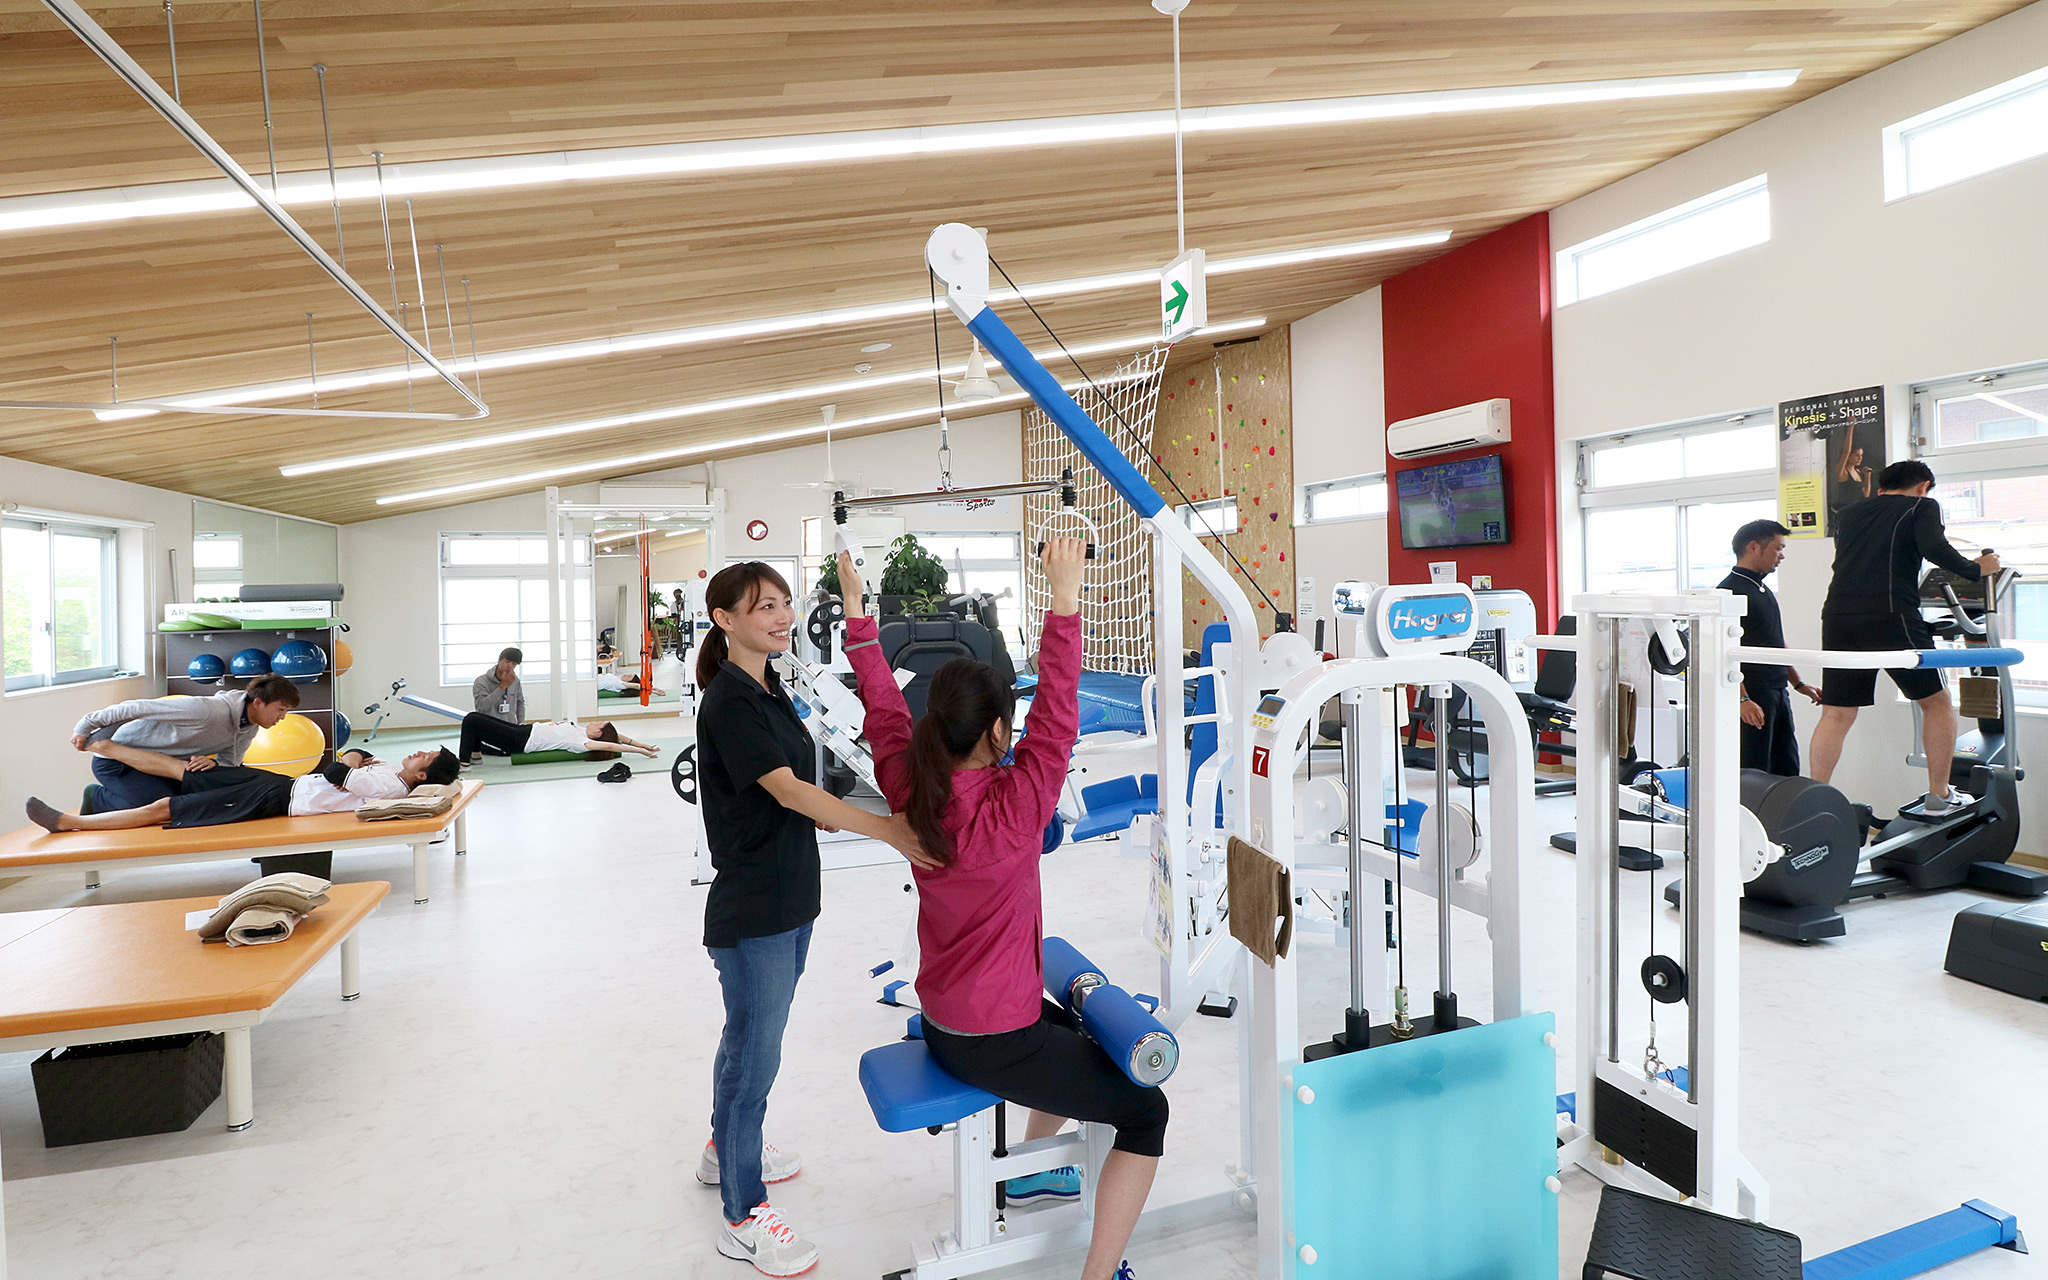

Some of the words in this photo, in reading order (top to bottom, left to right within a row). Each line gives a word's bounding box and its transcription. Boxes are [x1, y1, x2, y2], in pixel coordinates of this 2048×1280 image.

[1784, 402, 1828, 414] PERSONAL
[1833, 393, 1878, 406] TRAINING
[1784, 411, 1827, 427] Kinesis
[1828, 411, 1837, 420] +
[1839, 405, 1878, 419] Shape
[965, 499, 996, 511] Sports
[1393, 604, 1468, 631] Hogrel
[1256, 749, 1267, 773] 7
